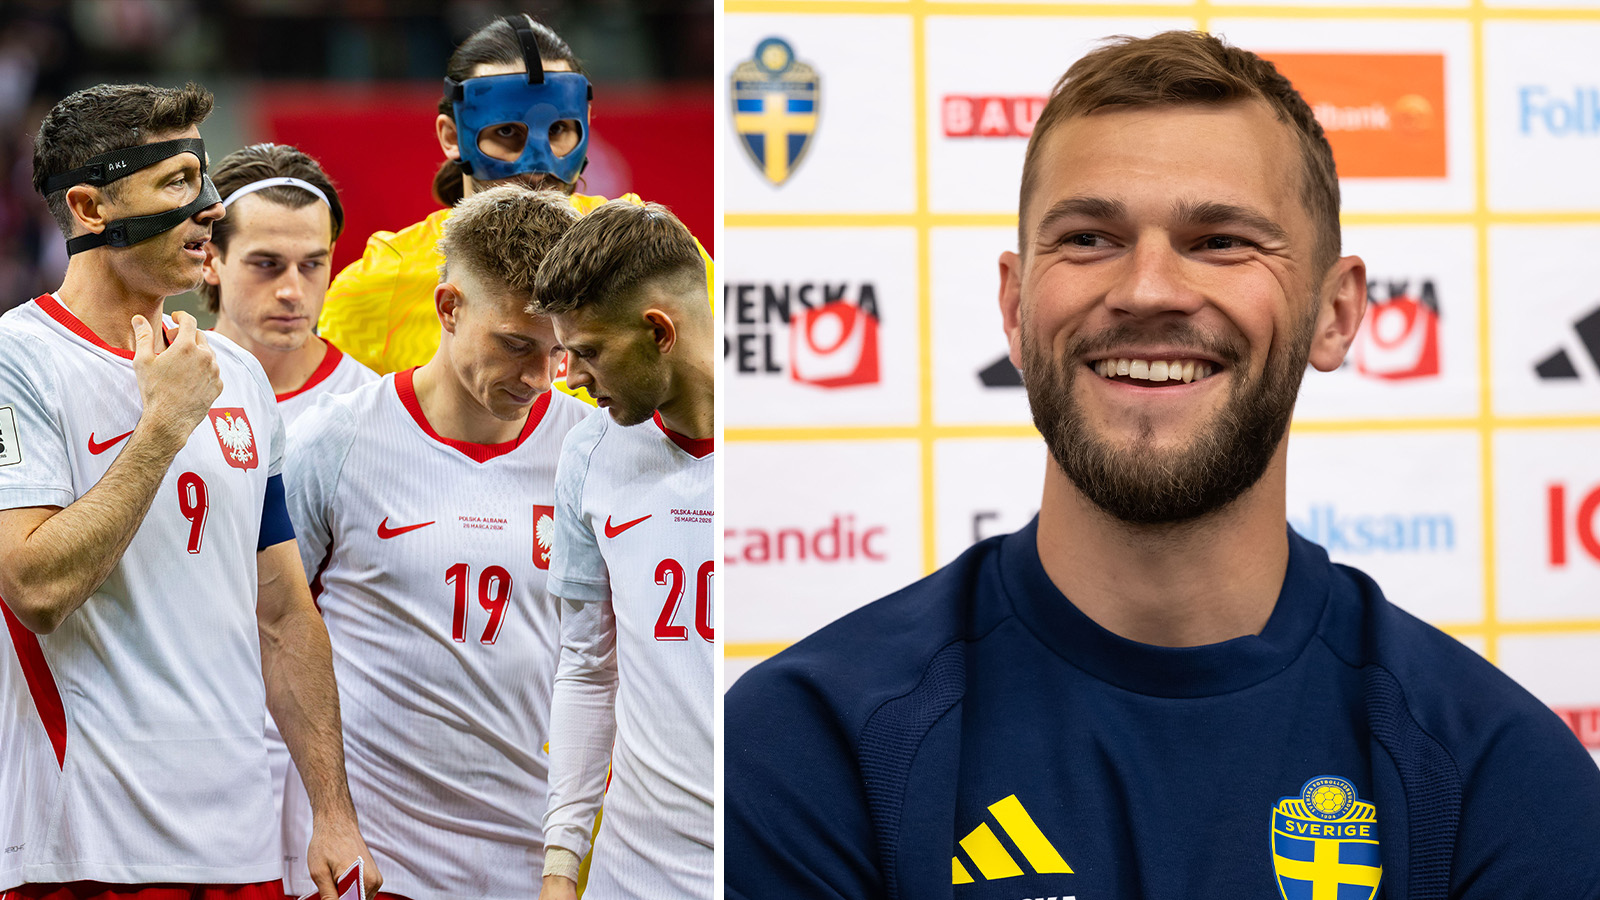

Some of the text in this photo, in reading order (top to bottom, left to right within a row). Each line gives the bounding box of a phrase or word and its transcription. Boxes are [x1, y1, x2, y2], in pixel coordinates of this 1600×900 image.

[108, 160, 127, 171] AKL
[177, 471, 209, 554] 9
[445, 563, 513, 645] 19
[1285, 820, 1371, 837] SVERIGE
